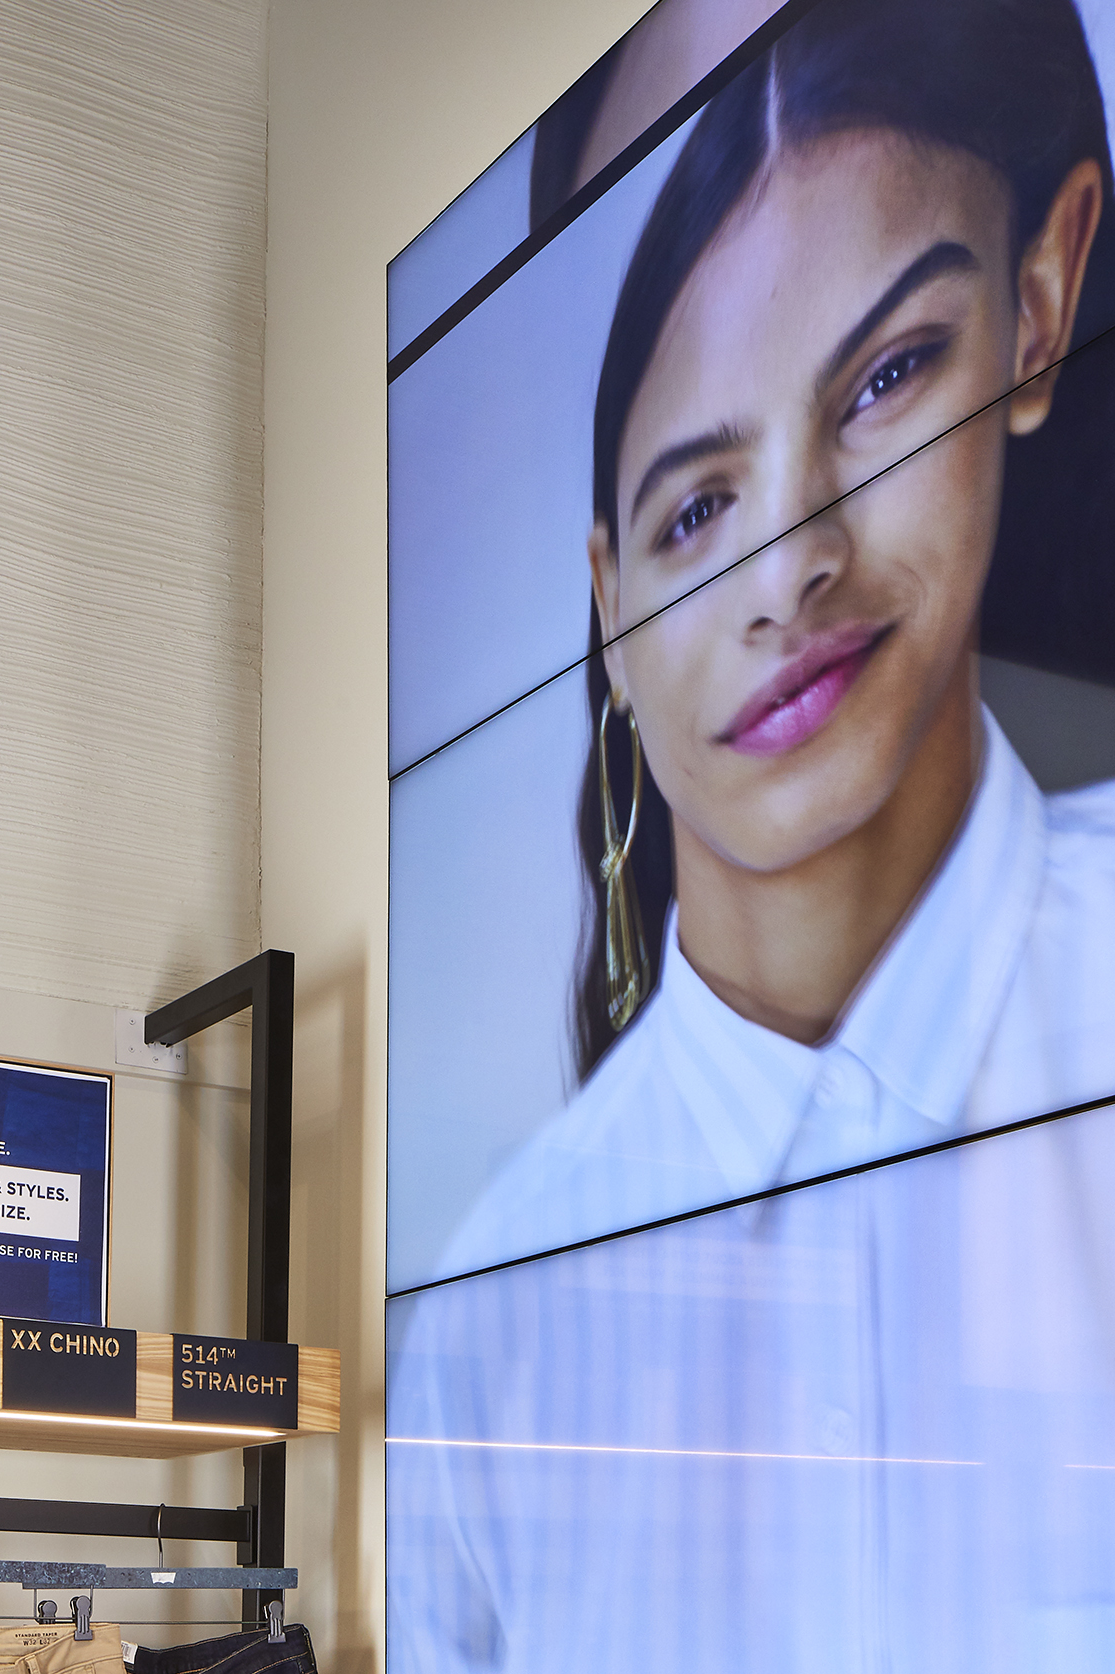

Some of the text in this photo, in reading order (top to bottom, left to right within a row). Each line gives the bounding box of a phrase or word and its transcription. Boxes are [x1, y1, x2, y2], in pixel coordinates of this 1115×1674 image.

[7, 1182, 69, 1202] STYLES.
[18, 1248, 41, 1259] FOR
[45, 1250, 78, 1263] FREE!
[11, 1329, 120, 1357] XX CHINO
[182, 1370, 287, 1395] STRAIGHT
